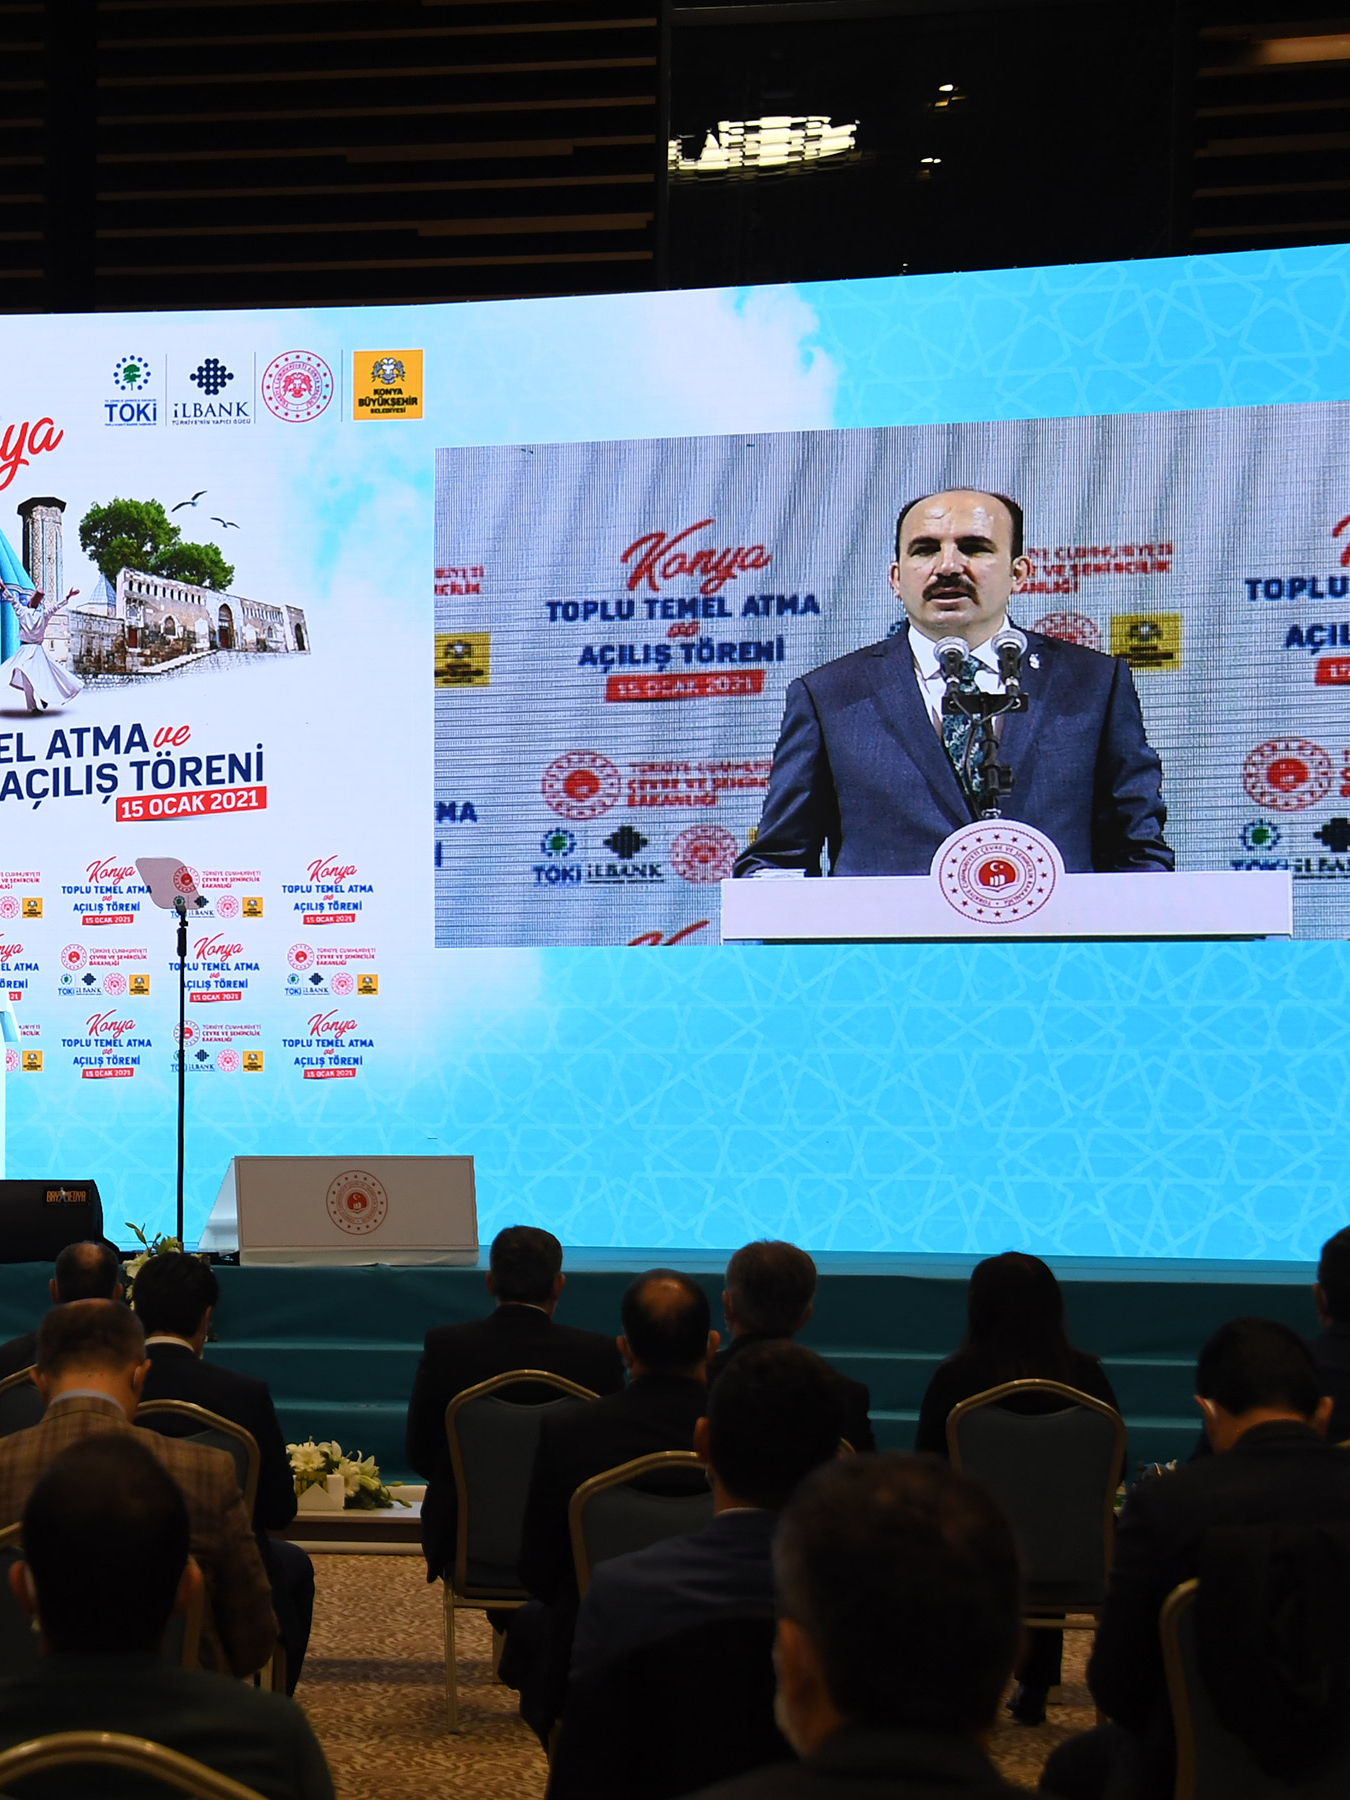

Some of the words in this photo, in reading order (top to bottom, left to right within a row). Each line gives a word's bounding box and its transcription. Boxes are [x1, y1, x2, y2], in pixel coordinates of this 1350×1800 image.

[358, 396, 418, 408] BÜYÜKŞEHİR
[620, 518, 772, 596] Konya
[1245, 576, 1350, 601] TOPLU
[546, 600, 635, 622] TOPLU
[644, 596, 732, 620] TEMEL
[742, 594, 820, 617] ATMA
[1284, 624, 1350, 656] AÇIL
[578, 644, 671, 674] AÇILIŞ
[680, 634, 785, 664] TÖRENİ
[46, 722, 150, 760] ATMA
[152, 722, 191, 749] ve
[129, 743, 264, 792] TÖRENİ
[120, 800, 144, 818] 15
[148, 796, 206, 817] OCAK
[210, 791, 260, 811] 2021
[87, 856, 136, 885] Konya
[308, 855, 357, 884] Konya
[62, 886, 92, 894] TOPLU
[94, 886, 124, 894] TEMEL
[126, 886, 152, 894] ATMA
[282, 885, 312, 893] TOPLU
[315, 885, 345, 893] TEMEL
[348, 885, 373, 893] ATMA
[74, 903, 104, 914] AÇILIŞ
[107, 901, 140, 911] TÖRENİ
[294, 903, 325, 913] AÇILIŞ
[328, 900, 362, 911] TÖRENİ
[194, 933, 243, 962] Konya
[14, 963, 39, 971] ATMA
[169, 963, 199, 971] TOLU
[202, 963, 231, 971] TEMEL
[234, 963, 259, 971] ATMA
[214, 978, 248, 988] TÖRENİ
[87, 1009, 136, 1038] Konya
[308, 1009, 358, 1039] Konya
[62, 1038, 92, 1047] TOPLU
[94, 1038, 124, 1047] TEMEL
[126, 1038, 152, 1047] ATMA
[282, 1039, 313, 1048] TOPLU
[316, 1039, 345, 1048] TEMEL
[348, 1039, 374, 1048] ATMA
[74, 1056, 104, 1067] AÇILIŞ
[107, 1054, 140, 1064] TÖRENİ
[294, 1057, 325, 1068] AÇILIŞ
[328, 1054, 362, 1065] TÖRENİ
